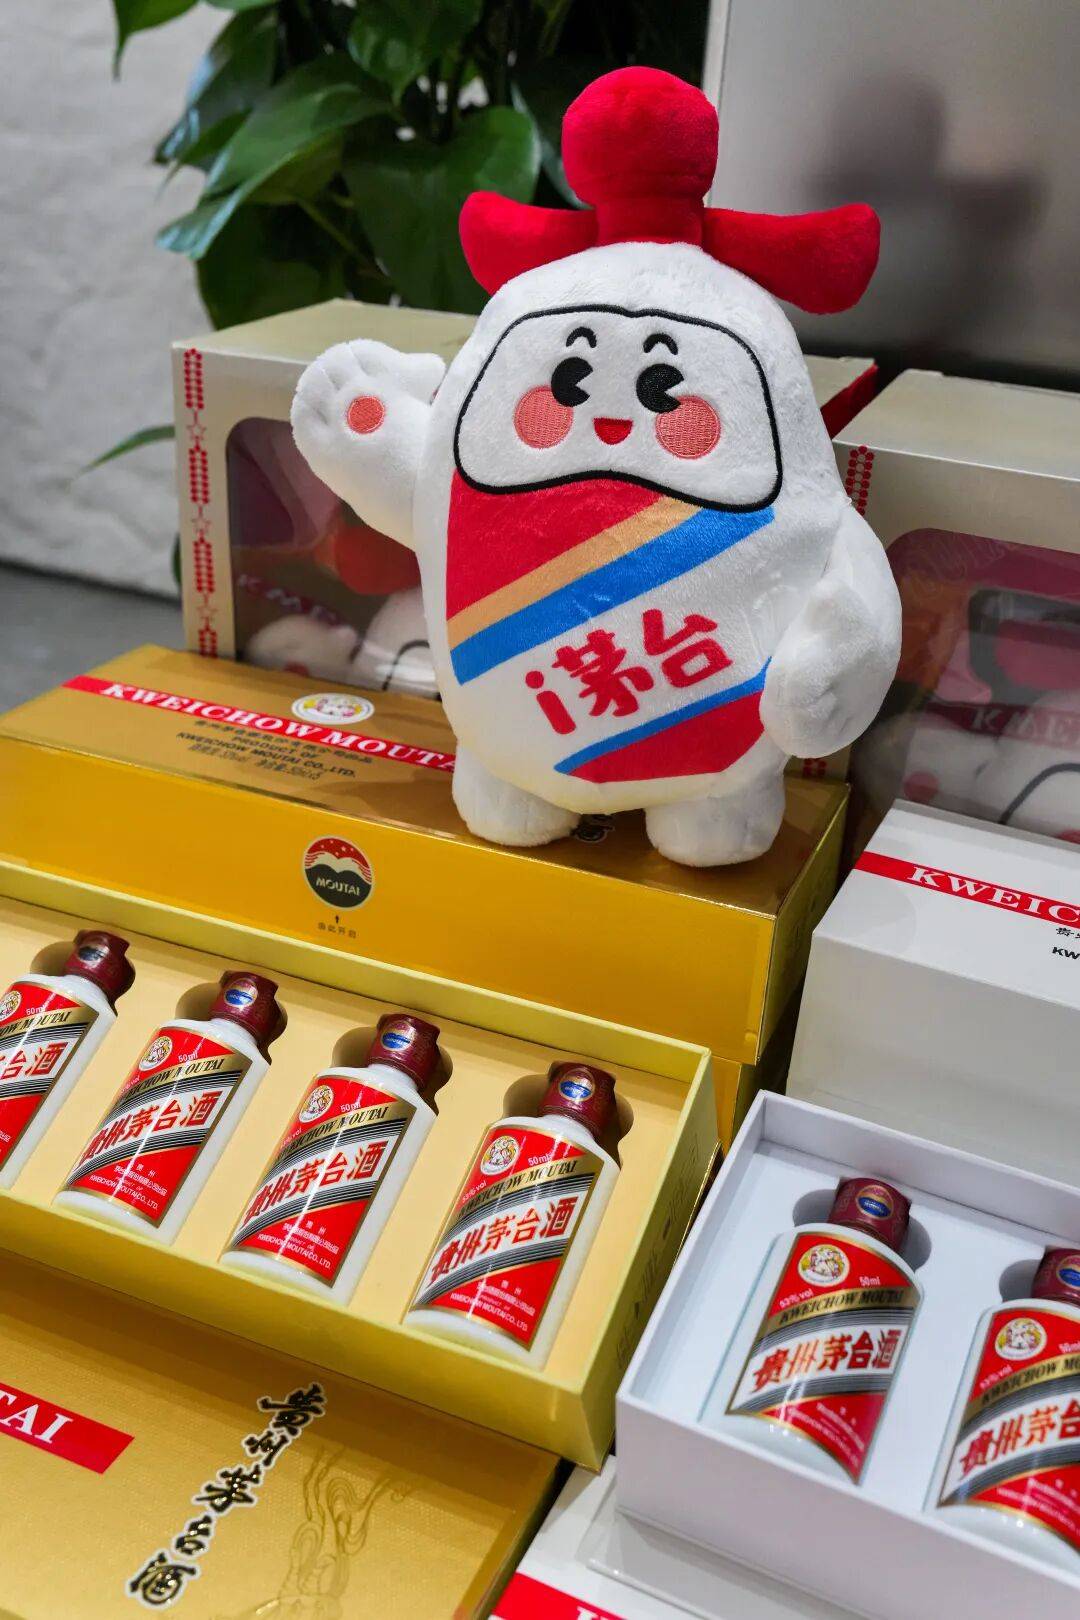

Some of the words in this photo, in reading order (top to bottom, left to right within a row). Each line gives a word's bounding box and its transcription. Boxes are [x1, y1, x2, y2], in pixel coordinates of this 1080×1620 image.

[525, 609, 733, 734] i茅台
[101, 683, 325, 739] KWEICHOW
[176, 732, 246, 752] KWEICHOW
[251, 748, 301, 764] MOUTAI
[315, 876, 361, 897] MOUTAI
[0, 1042, 69, 1080] 台酒
[859, 1275, 881, 1287] 50ml
[752, 1330, 902, 1393] 贵州茅台酒
